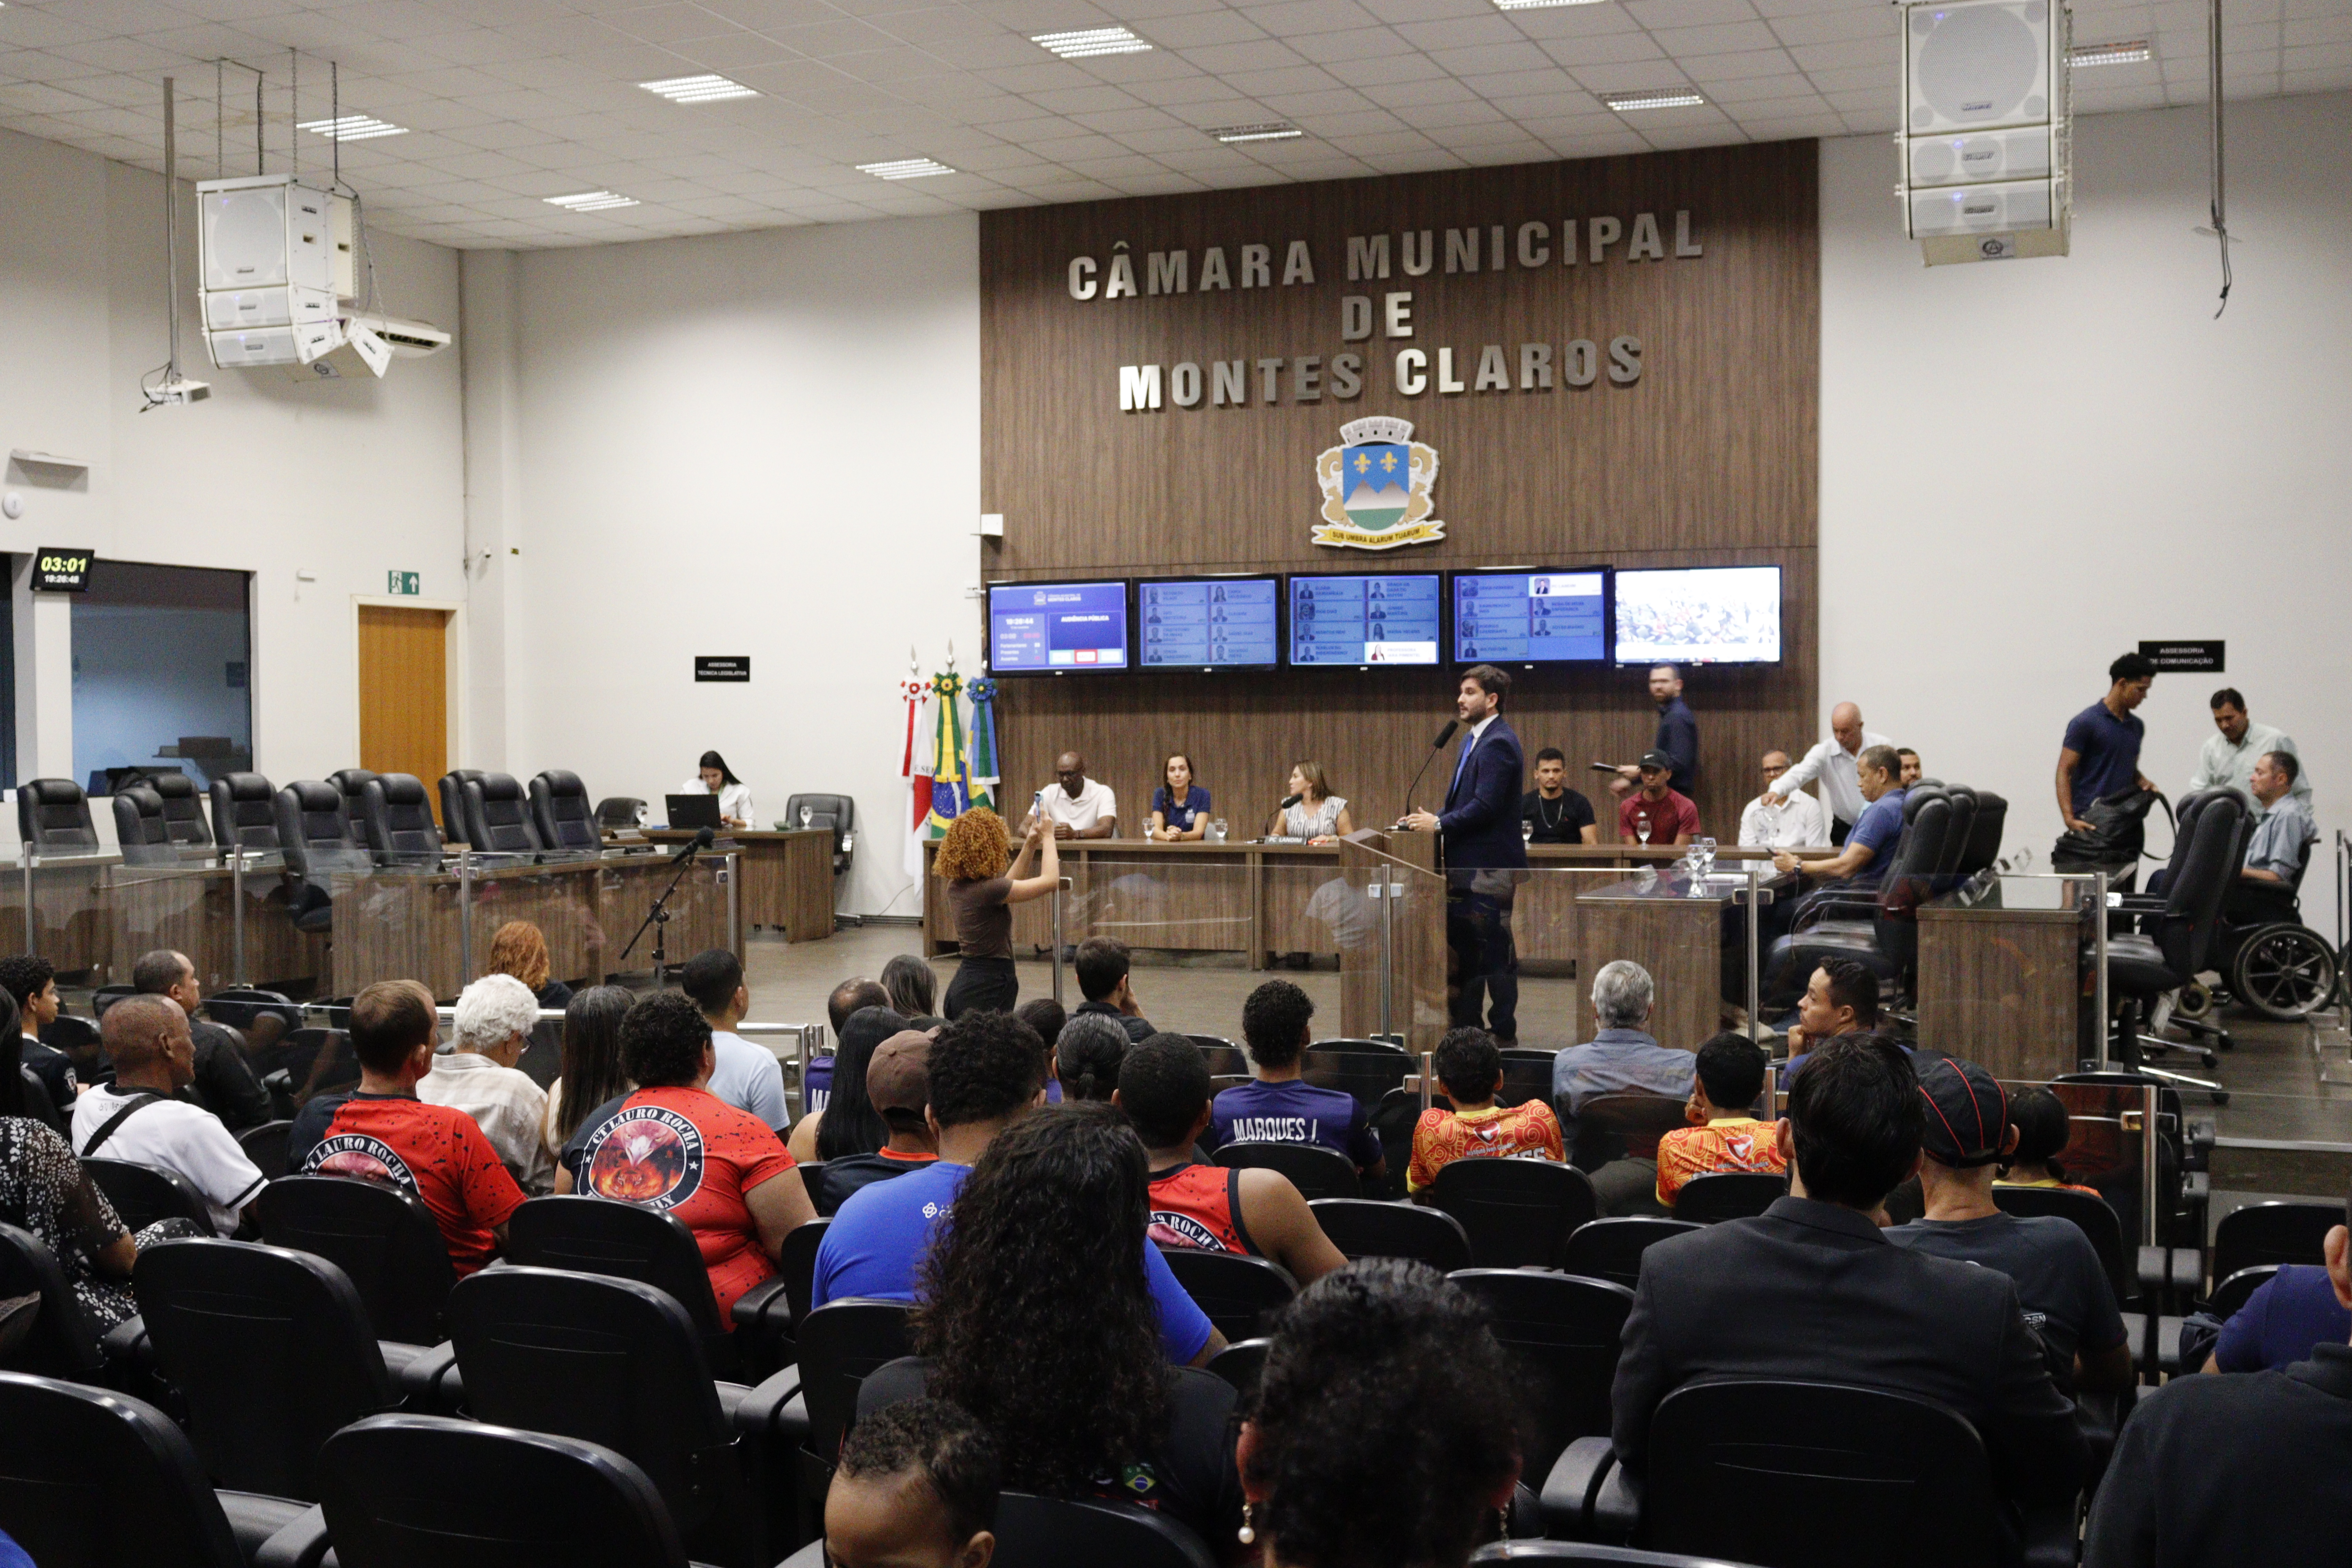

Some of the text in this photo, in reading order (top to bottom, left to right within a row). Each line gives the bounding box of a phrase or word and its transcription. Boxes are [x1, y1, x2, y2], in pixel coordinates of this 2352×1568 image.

[1067, 210, 1703, 301] CÂMARA MUNICIPAL
[1341, 291, 1414, 341] DE
[1119, 335, 1642, 412] MONTES CLAROS
[1346, 534, 1367, 543] UMBRA
[1369, 534, 1394, 544] ALARUM
[1396, 528, 1421, 539] TUARUM
[41, 556, 87, 573] 03:01
[592, 1108, 700, 1151] CT LAURO ROCHA
[1233, 1118, 1306, 1142] MARQUES
[316, 1137, 365, 1161] LAURO
[367, 1142, 411, 1187] ROCHA
